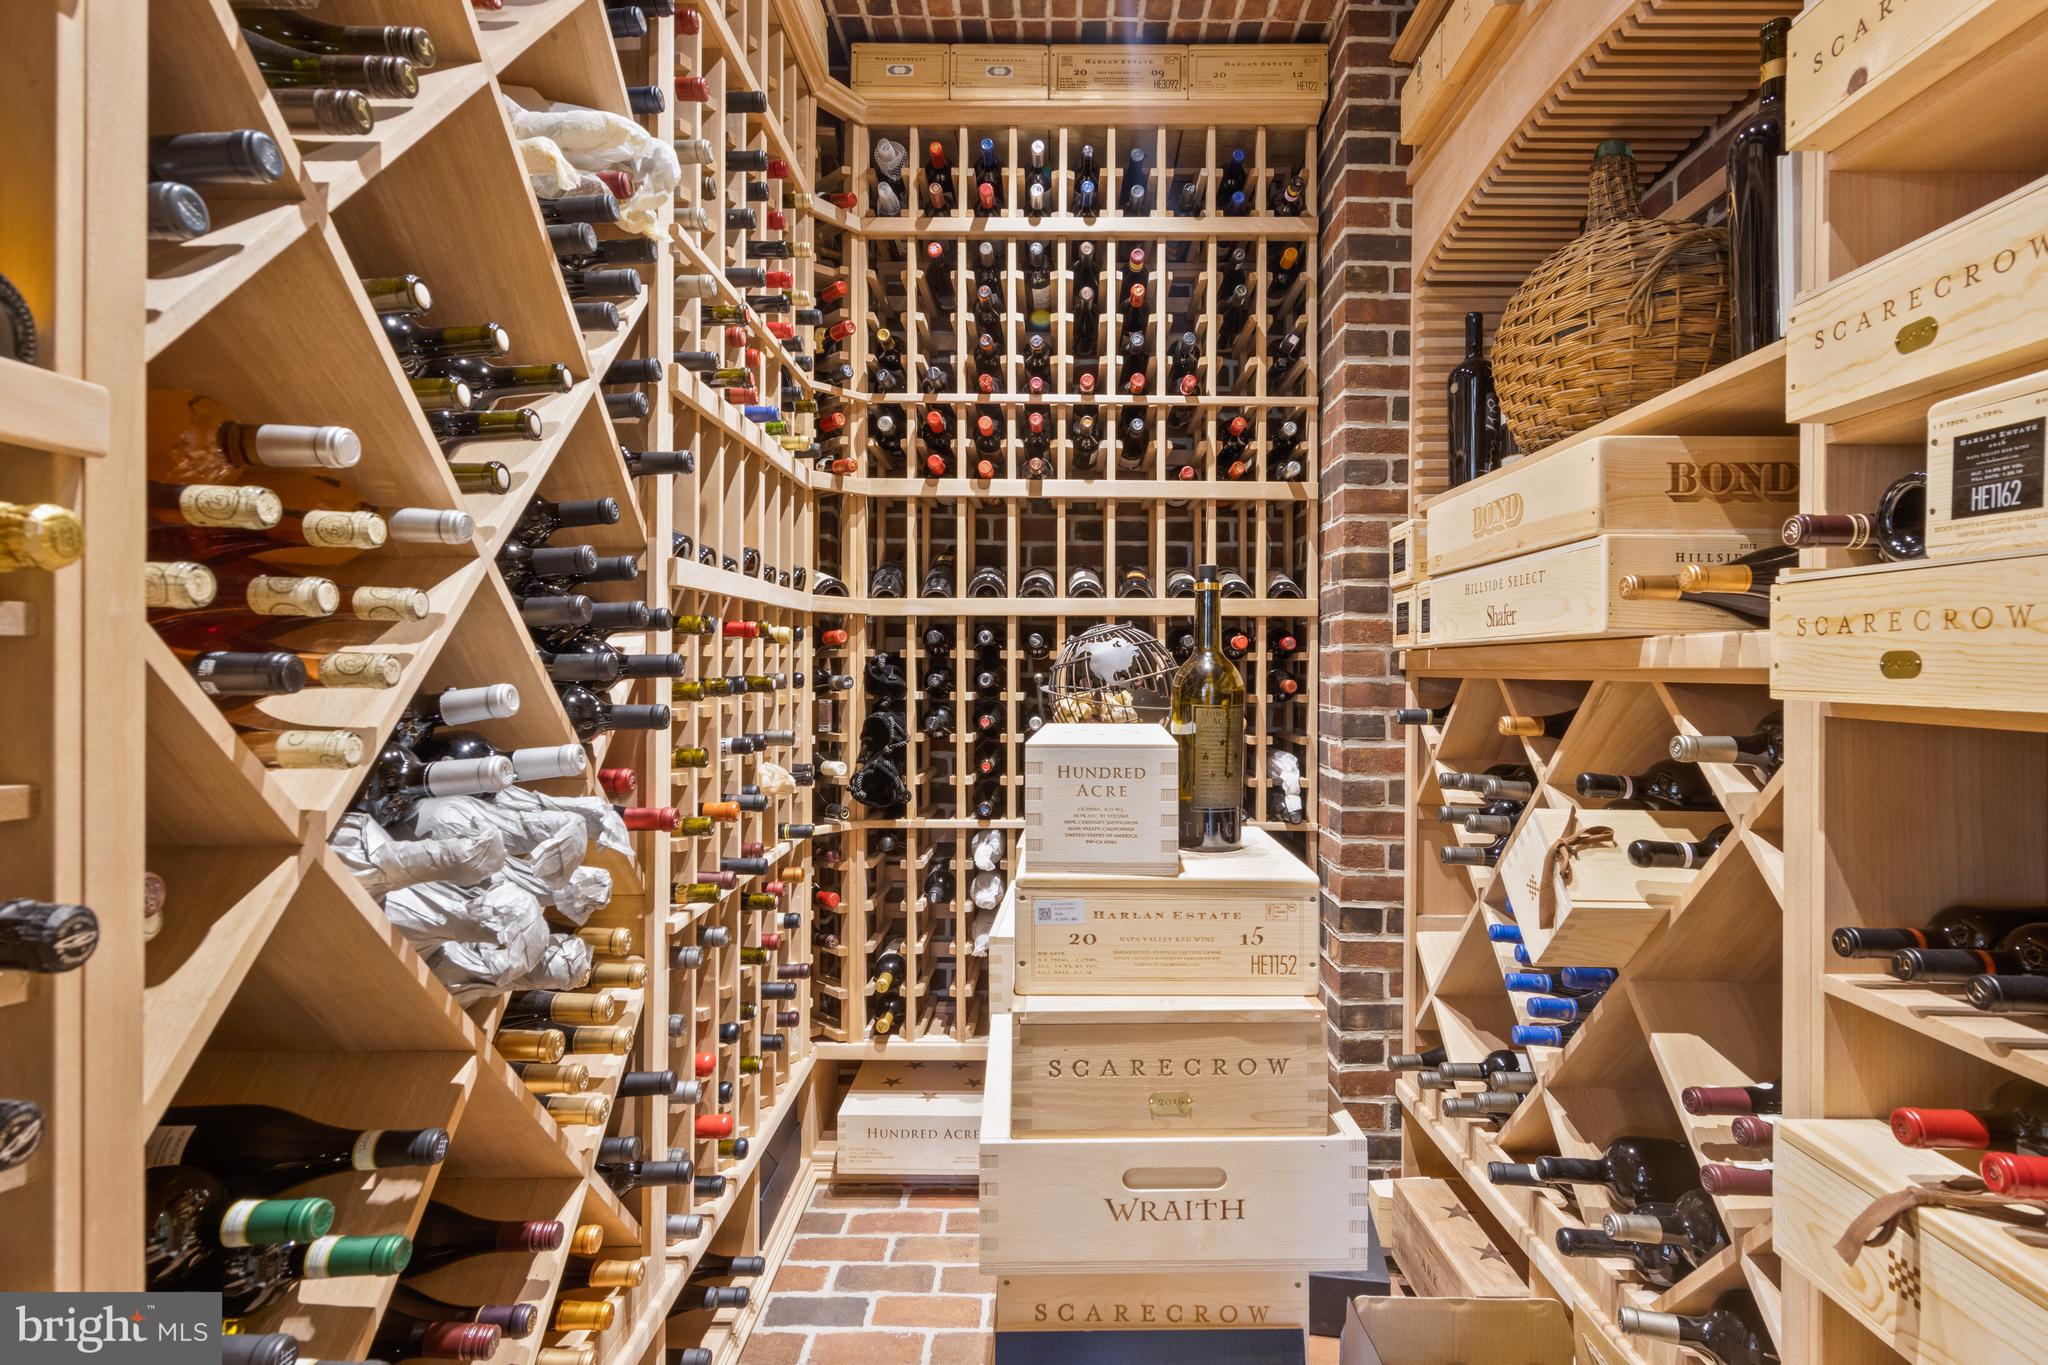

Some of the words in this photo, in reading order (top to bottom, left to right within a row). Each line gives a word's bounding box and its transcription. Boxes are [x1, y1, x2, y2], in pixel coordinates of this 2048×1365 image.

[1814, 233, 2048, 351] SCARECROW
[1959, 433, 1997, 446] HARLAN
[1999, 424, 2039, 438] ESTATE
[1666, 462, 1800, 503] BOND
[1971, 479, 2022, 512] HE1162
[1472, 492, 1524, 540] BOND
[1465, 578, 1504, 596] HILLSIDE
[1486, 603, 1517, 628] Shafer
[1797, 604, 2036, 637] SCARECROW
[1057, 765, 1147, 779] HUNDRED
[1077, 784, 1128, 797] ACRE
[1093, 911, 1164, 920] HARLAN
[1173, 911, 1242, 920] ESTATE
[1069, 933, 1097, 945] 20
[1240, 926, 1264, 946] 15
[1251, 954, 1297, 975] HE1152
[1048, 1057, 1291, 1079] SCARECROW
[867, 1127, 938, 1140] HUNDRED
[1104, 1197, 1246, 1222] WRAITH
[1034, 1303, 1270, 1324] SCARECROW
